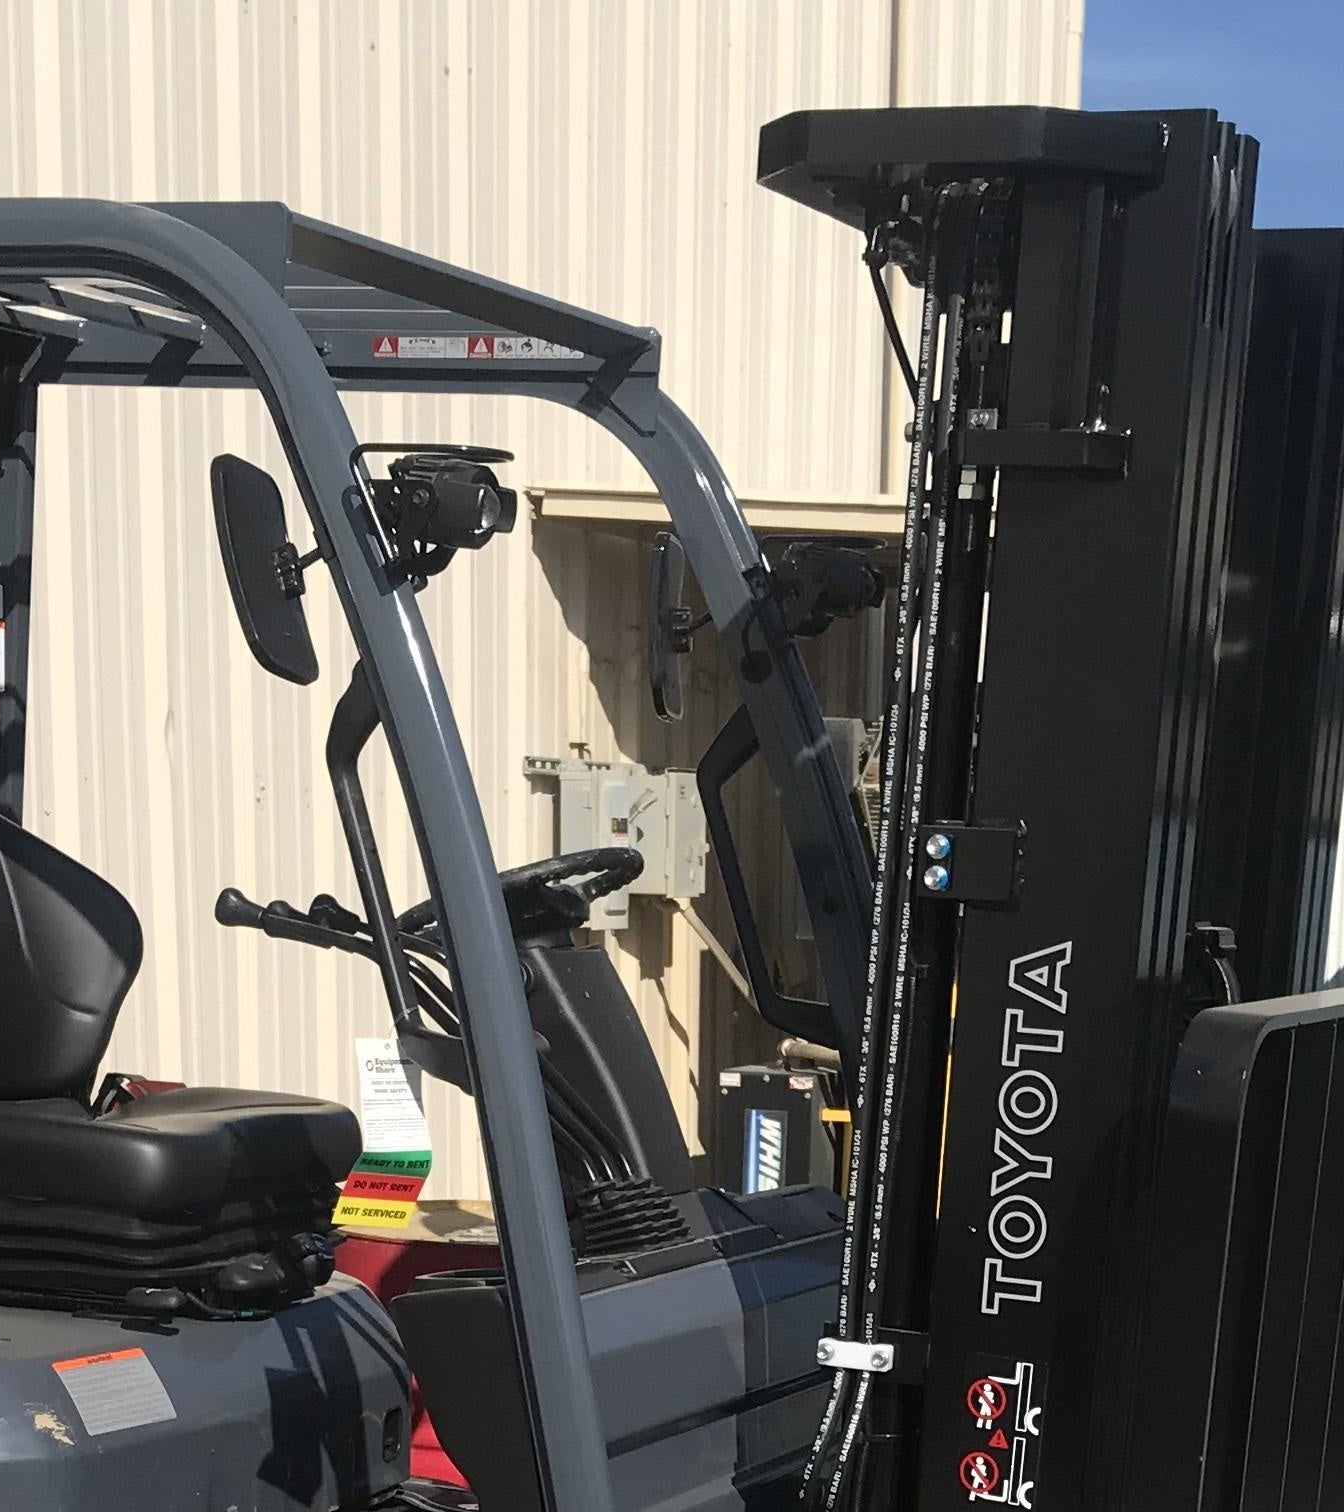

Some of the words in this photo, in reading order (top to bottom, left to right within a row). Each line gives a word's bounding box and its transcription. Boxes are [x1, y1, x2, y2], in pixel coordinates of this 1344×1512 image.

[923, 299, 934, 329] MSHA
[921, 334, 931, 360] WIRE
[949, 393, 957, 411] 6TX
[911, 441, 922, 464] BAR)
[908, 491, 917, 507] WP
[907, 509, 916, 524] PSI
[905, 527, 914, 548] 4000
[935, 540, 945, 566] WIRE
[896, 636, 904, 654] 6TX
[925, 644, 936, 668] BAR)
[924, 670, 933, 690] (276
[922, 693, 930, 709] WP
[920, 711, 929, 727] PSI
[918, 729, 927, 750] 4000
[885, 747, 896, 774] MSHA
[883, 779, 893, 803] WIRE
[874, 881, 884, 903] BAR)
[872, 905, 882, 924] (276
[870, 928, 879, 943] WP
[869, 945, 878, 960] PSI
[897, 944, 908, 971] MSHA
[867, 962, 876, 983] 4000
[895, 975, 904, 999] WIRE
[859, 1065, 867, 1082] 6TX
[885, 1073, 895, 1095] BAR)
[883, 1097, 892, 1115] (276
[882, 1119, 890, 1134] WP
[981, 940, 1073, 1315] TOYOTA
[880, 1136, 889, 1150] PSI
[360, 1158, 390, 1169] READY
[393, 1160, 404, 1168] TO
[406, 1159, 429, 1169] RENT
[879, 1152, 887, 1172] 4000
[353, 1180, 366, 1189] DO
[369, 1181, 388, 1190] NOT
[390, 1183, 415, 1193] RENT
[849, 1170, 859, 1195] MSHA
[341, 1206, 359, 1216] NOT
[361, 1208, 406, 1219] SERVICED
[847, 1200, 856, 1222] WIRE
[874, 1204, 884, 1219] (9.5
[870, 1251, 879, 1267] 6TX
[840, 1294, 848, 1316] BAR)
[856, 1380, 868, 1401] WIRE
[803, 1462, 814, 1479] 6TX
